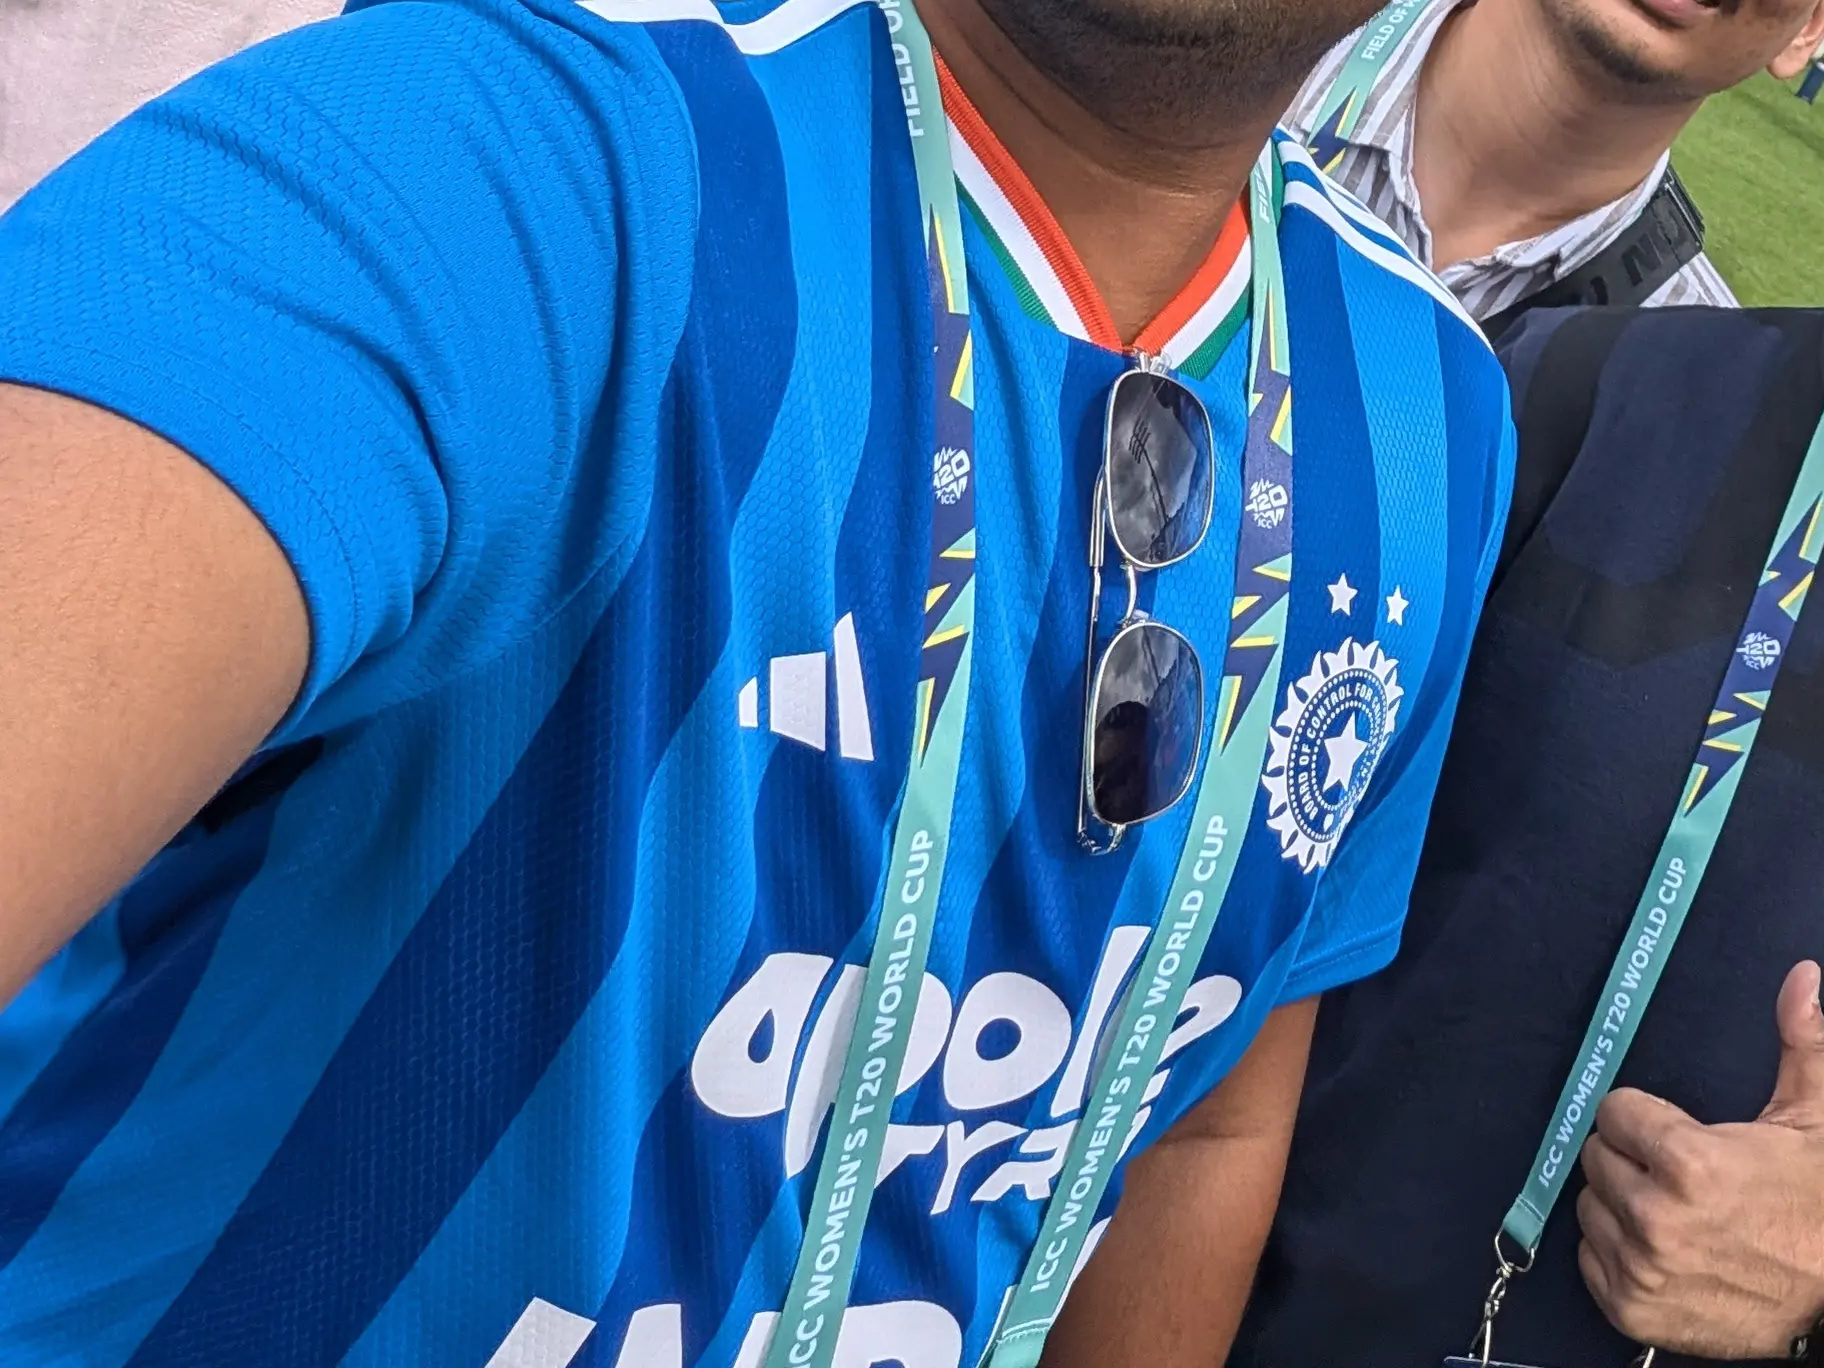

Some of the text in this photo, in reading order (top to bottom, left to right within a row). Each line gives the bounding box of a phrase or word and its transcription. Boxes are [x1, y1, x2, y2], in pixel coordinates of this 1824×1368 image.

[1361, 24, 1395, 60] FIELD
[1306, 683, 1353, 740] CONTROL
[1354, 682, 1374, 702] FOR
[1299, 744, 1312, 765] OF
[1298, 773, 1319, 821] BOARD
[1537, 856, 1688, 1190] ICC WOMEN'S T20 WORLD CUP
[804, 1127, 869, 1311] WOMEN'S
[846, 1056, 887, 1120] T20
[867, 912, 918, 1053] WORLD
[902, 829, 934, 904] CUP
[1030, 814, 1229, 1293] ICC WOMEN'S T20 WORLD CUP
